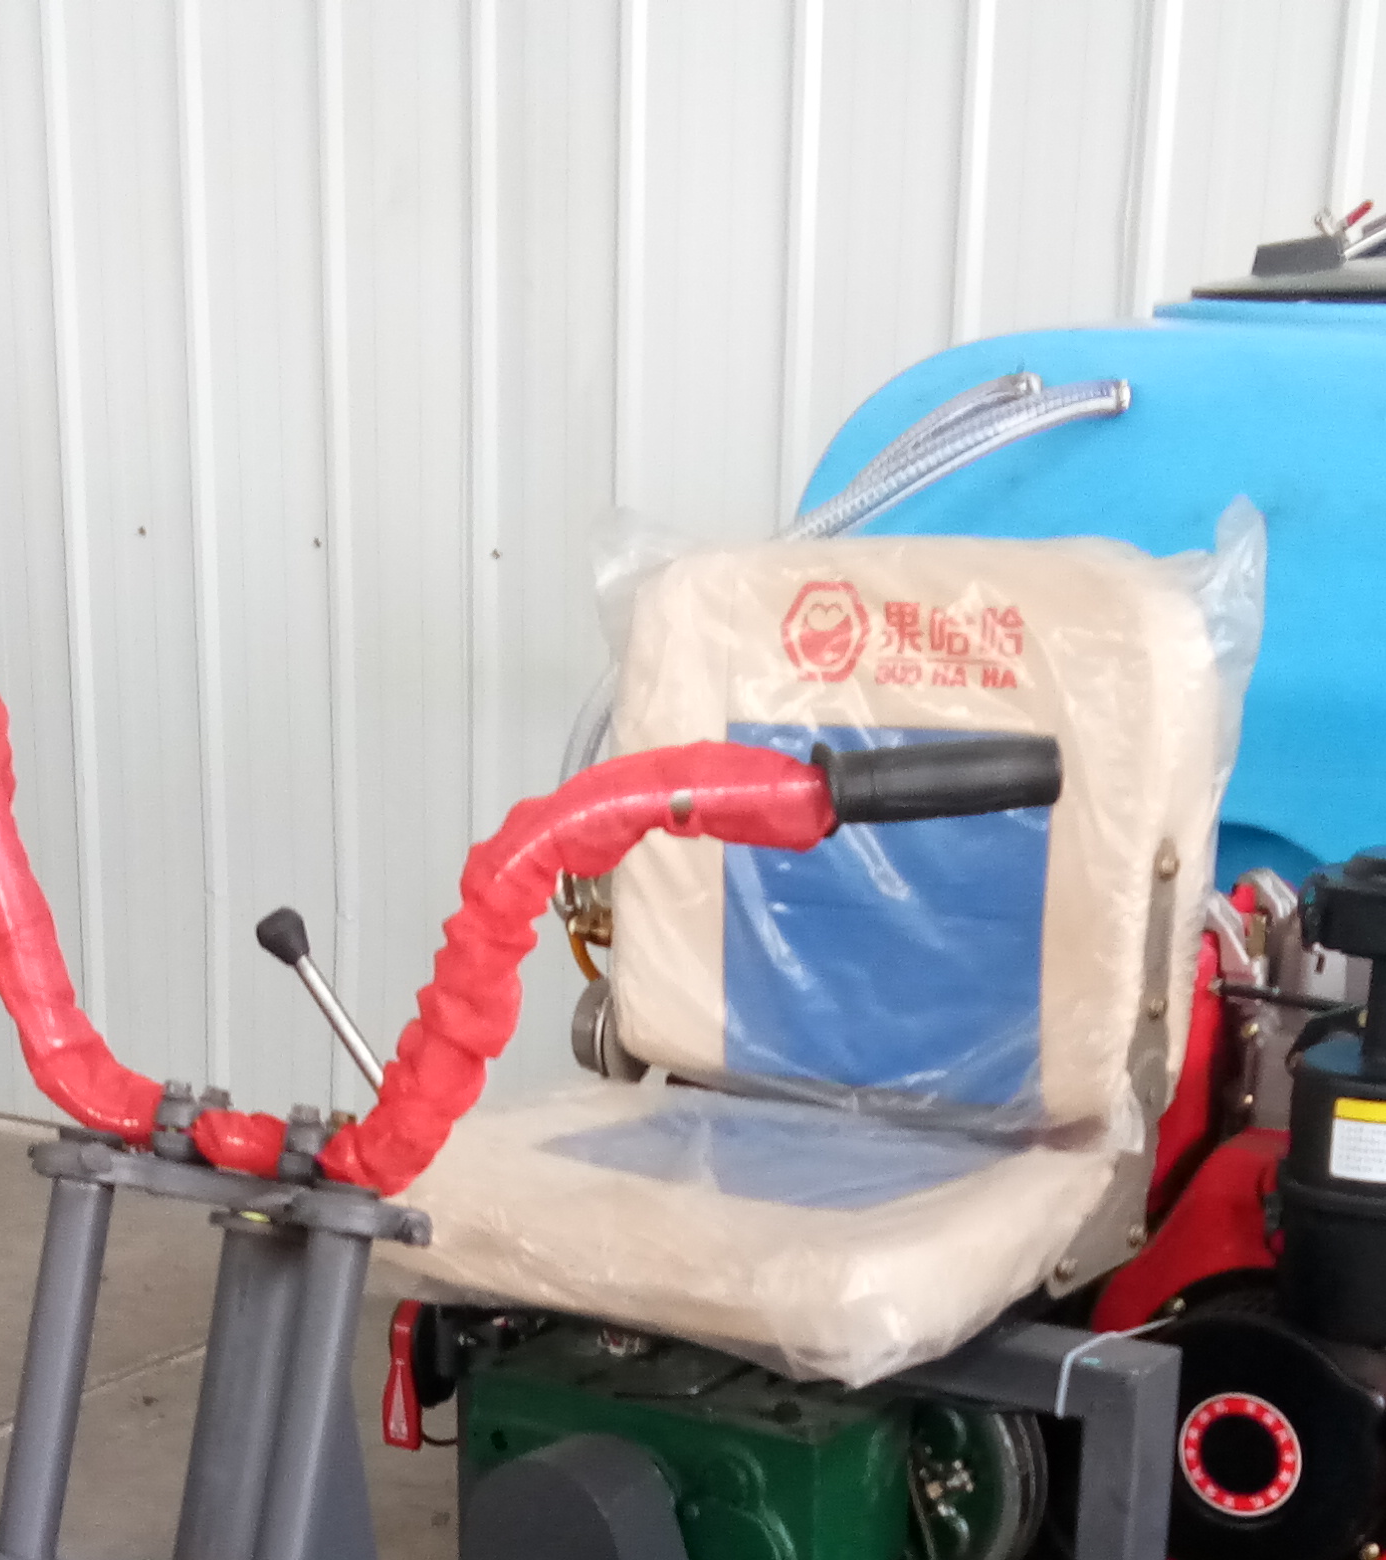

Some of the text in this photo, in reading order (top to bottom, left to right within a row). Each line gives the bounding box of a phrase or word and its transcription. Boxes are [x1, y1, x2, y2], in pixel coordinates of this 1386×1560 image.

[881, 601, 1024, 656] 果哈哈
[982, 667, 1017, 688] HA
